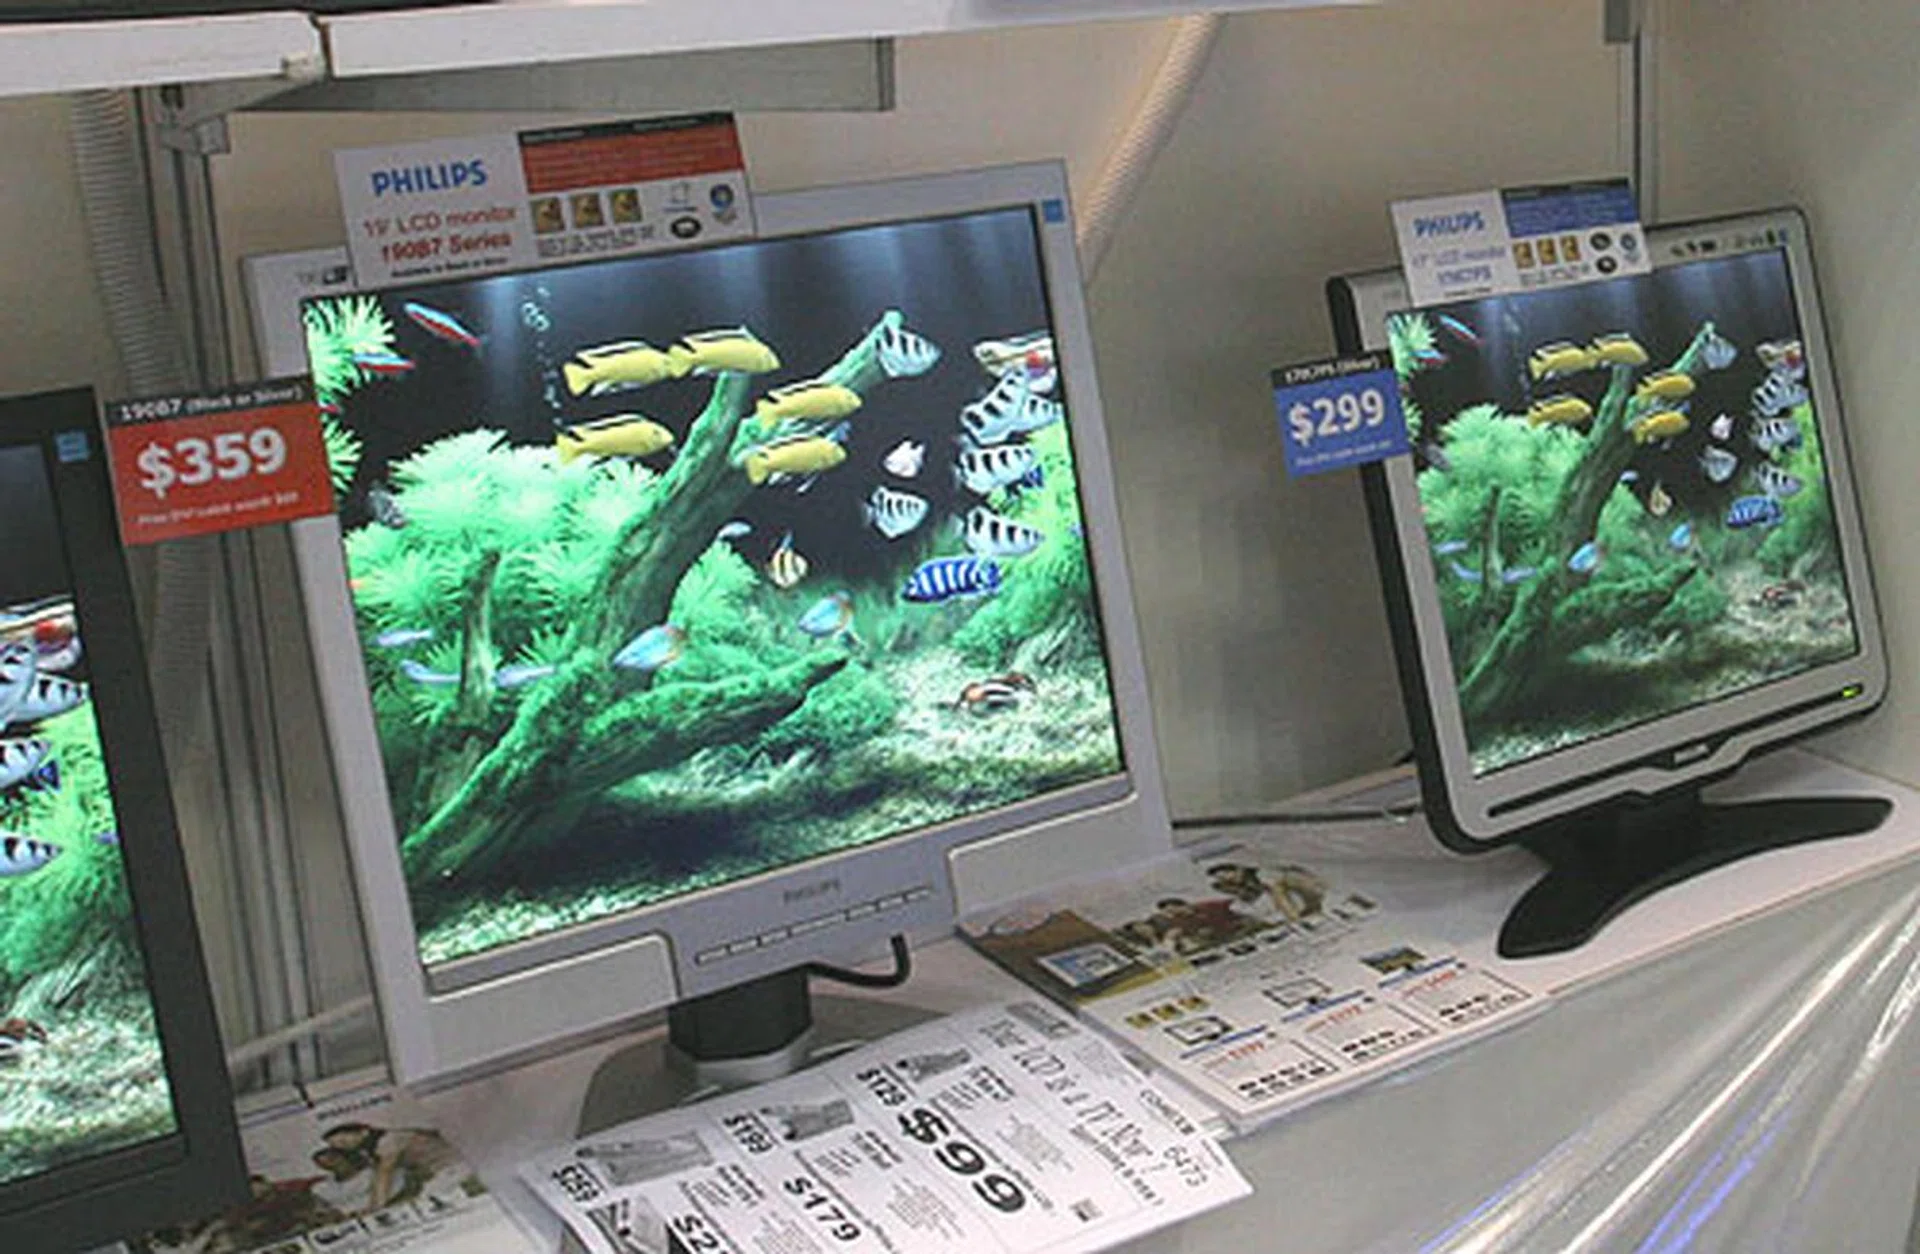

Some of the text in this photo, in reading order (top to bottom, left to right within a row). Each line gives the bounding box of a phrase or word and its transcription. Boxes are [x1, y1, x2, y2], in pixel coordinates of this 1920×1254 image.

[371, 160, 488, 198] PHILIPS
[396, 211, 441, 234] LCD
[446, 206, 516, 226] monitor
[449, 234, 513, 254] Series
[1289, 388, 1385, 447] $299
[137, 426, 288, 500] $359
[898, 1107, 1027, 1214] $99
[783, 1176, 862, 1242] $179
